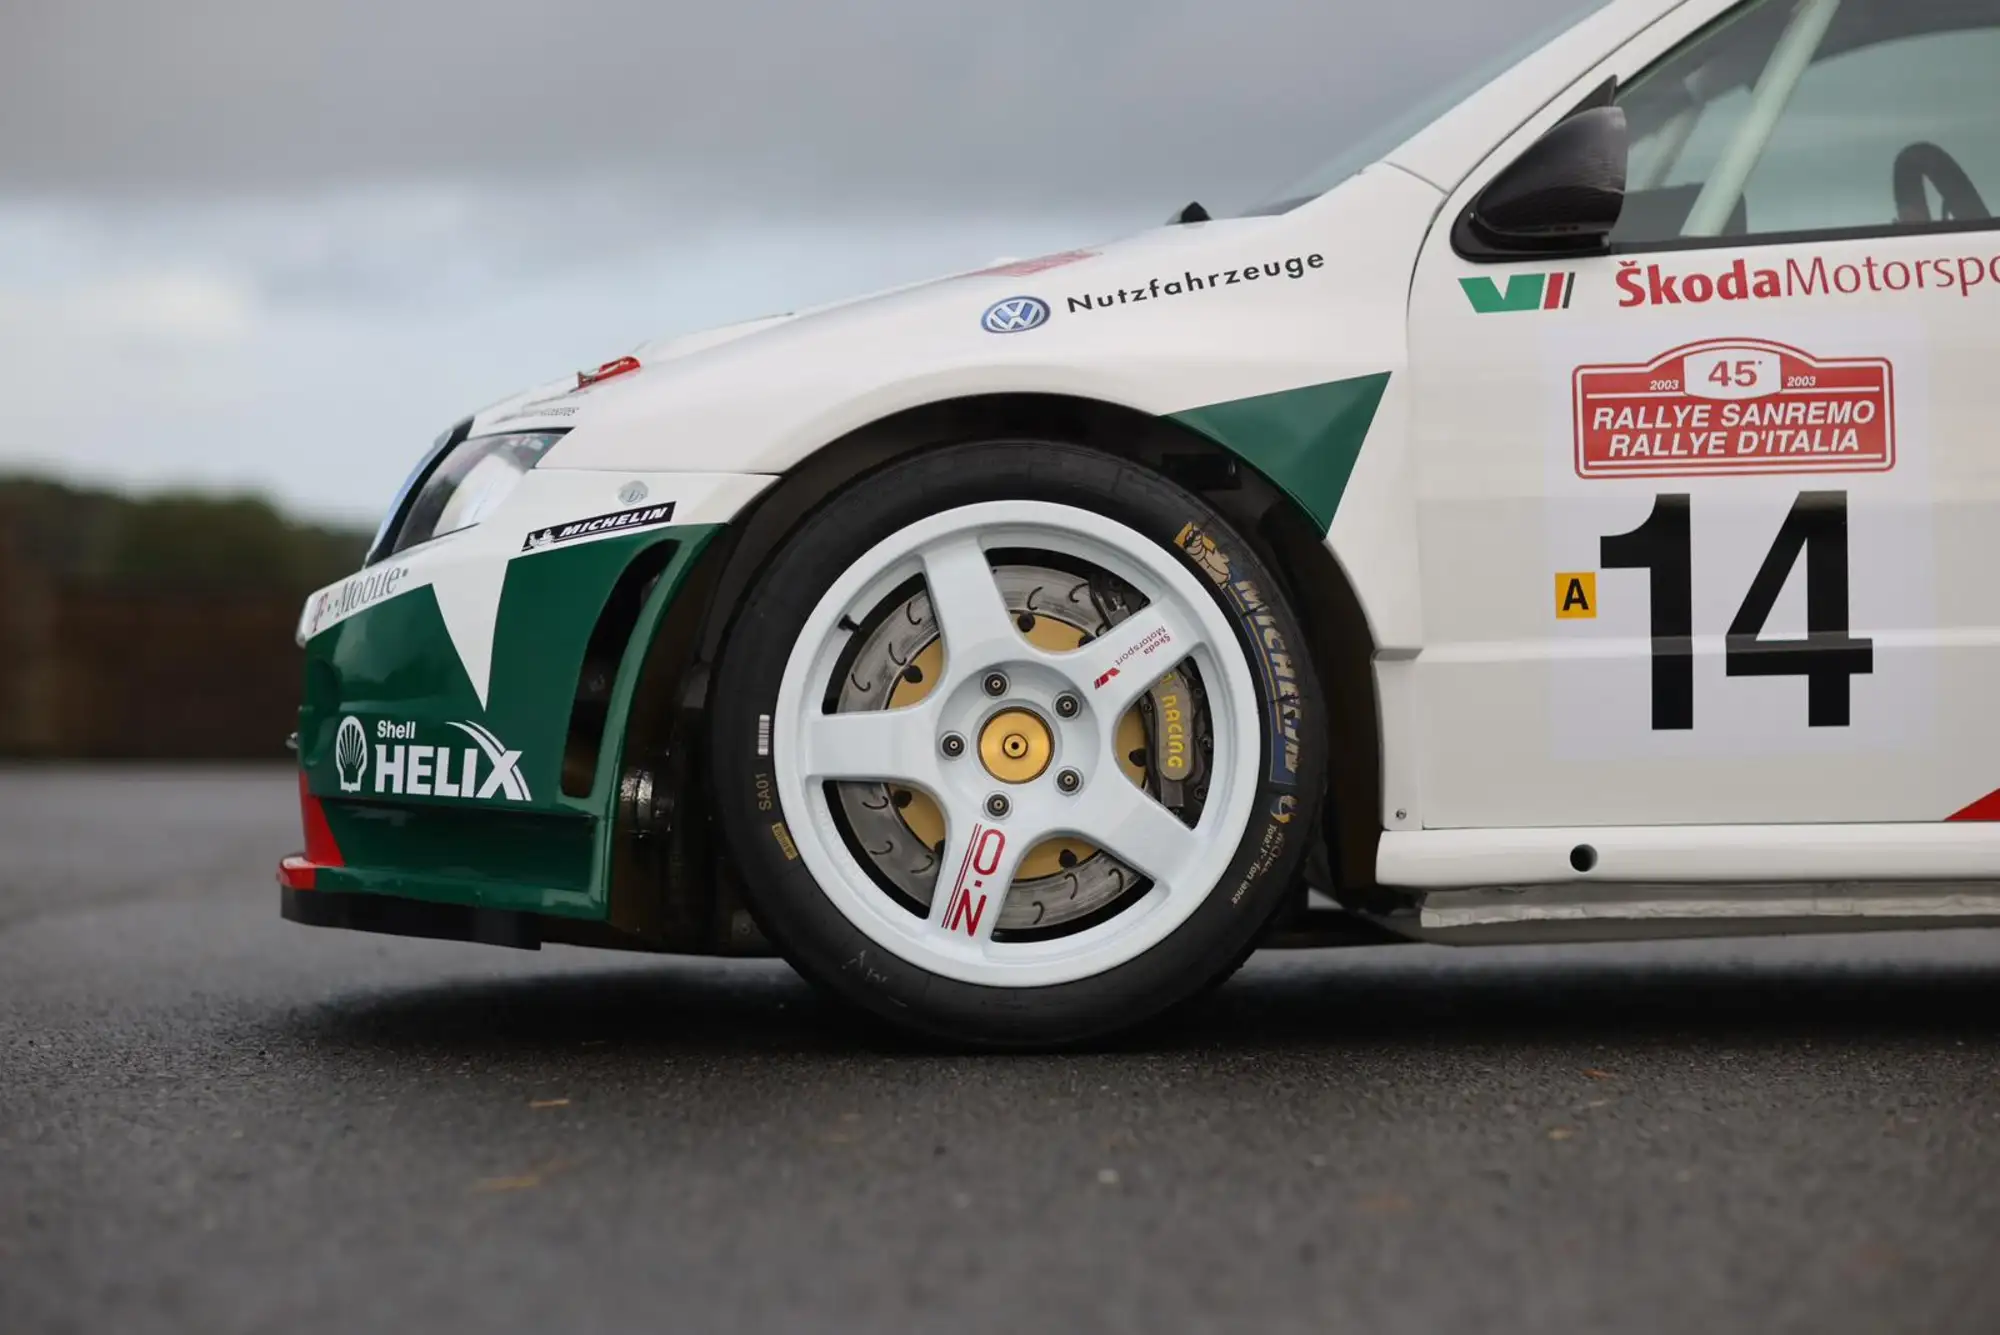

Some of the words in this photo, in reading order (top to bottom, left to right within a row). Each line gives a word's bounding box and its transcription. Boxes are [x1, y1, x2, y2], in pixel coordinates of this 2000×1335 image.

[1067, 253, 1325, 314] Nutzfahrzeuge
[1650, 380, 1680, 390] 2003
[1787, 376, 1817, 387] 2003
[1593, 404, 1712, 430] RALLYE
[1721, 400, 1875, 428] SANREMO
[1608, 432, 1727, 457] RALLYE
[1737, 428, 1859, 454] D'ITALIA
[559, 506, 669, 537] MICHELIN
[1562, 578, 1589, 611] A
[1600, 490, 1873, 730] 14
[1114, 625, 1167, 666] Motorsport
[376, 720, 416, 740] Shell
[375, 744, 531, 801] HELIX
[756, 771, 772, 812] SA01
